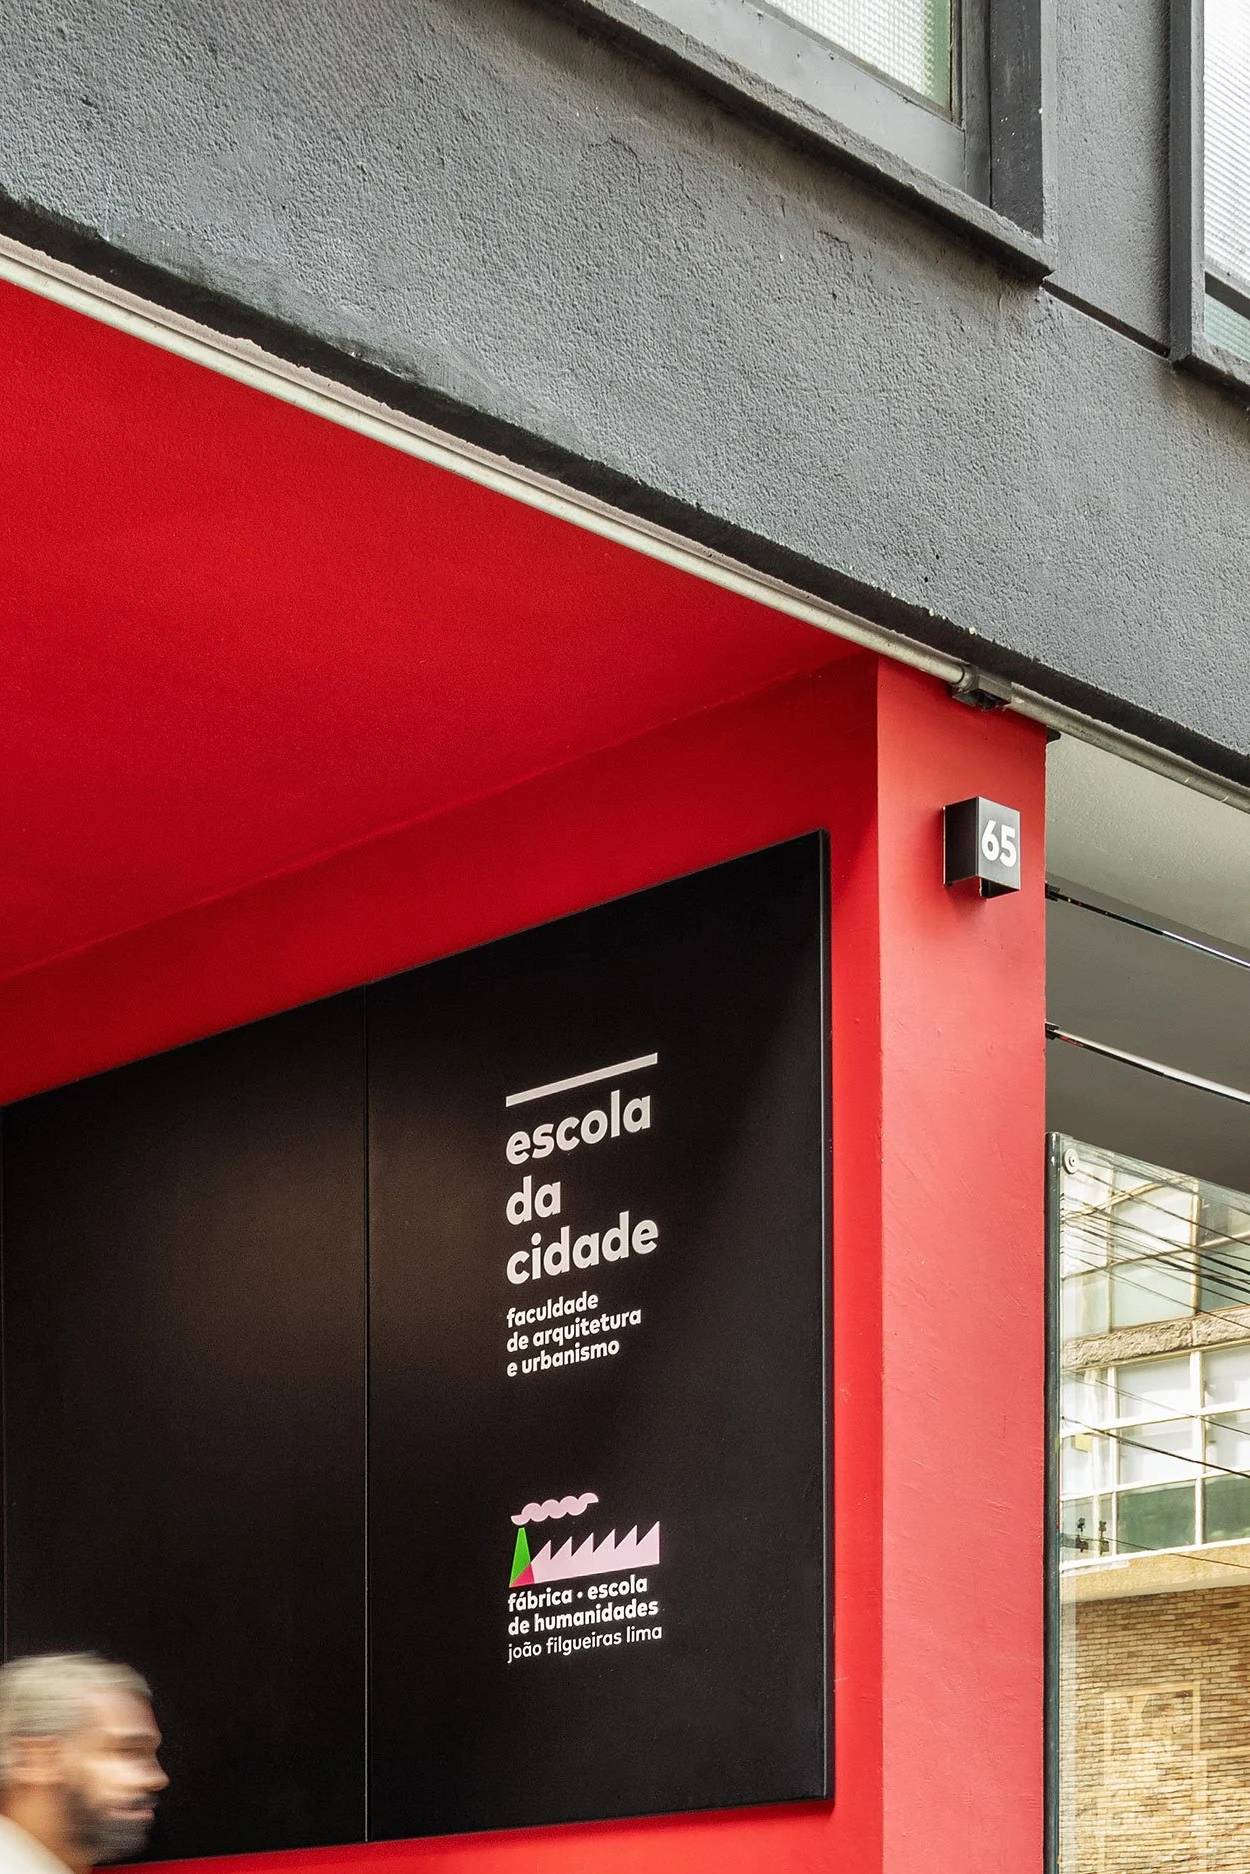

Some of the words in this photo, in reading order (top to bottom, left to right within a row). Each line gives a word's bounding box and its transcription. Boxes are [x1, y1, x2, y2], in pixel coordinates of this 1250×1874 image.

[981, 820, 1017, 867] 65
[506, 1090, 650, 1165] escola
[506, 1175, 561, 1225] da
[506, 1210, 659, 1284] cidade
[506, 1291, 599, 1328] faculdade
[507, 1332, 529, 1352] de
[533, 1309, 641, 1347] arquitetura
[507, 1361, 518, 1377] e
[521, 1340, 620, 1374] urbanismo
[507, 1588, 573, 1612] fábrica
[587, 1574, 648, 1599] escola
[508, 1617, 530, 1636] de
[534, 1599, 659, 1632] humanidades
[507, 1642, 542, 1664] joão
[546, 1629, 622, 1656] filgueiras
[626, 1626, 662, 1643] lima
